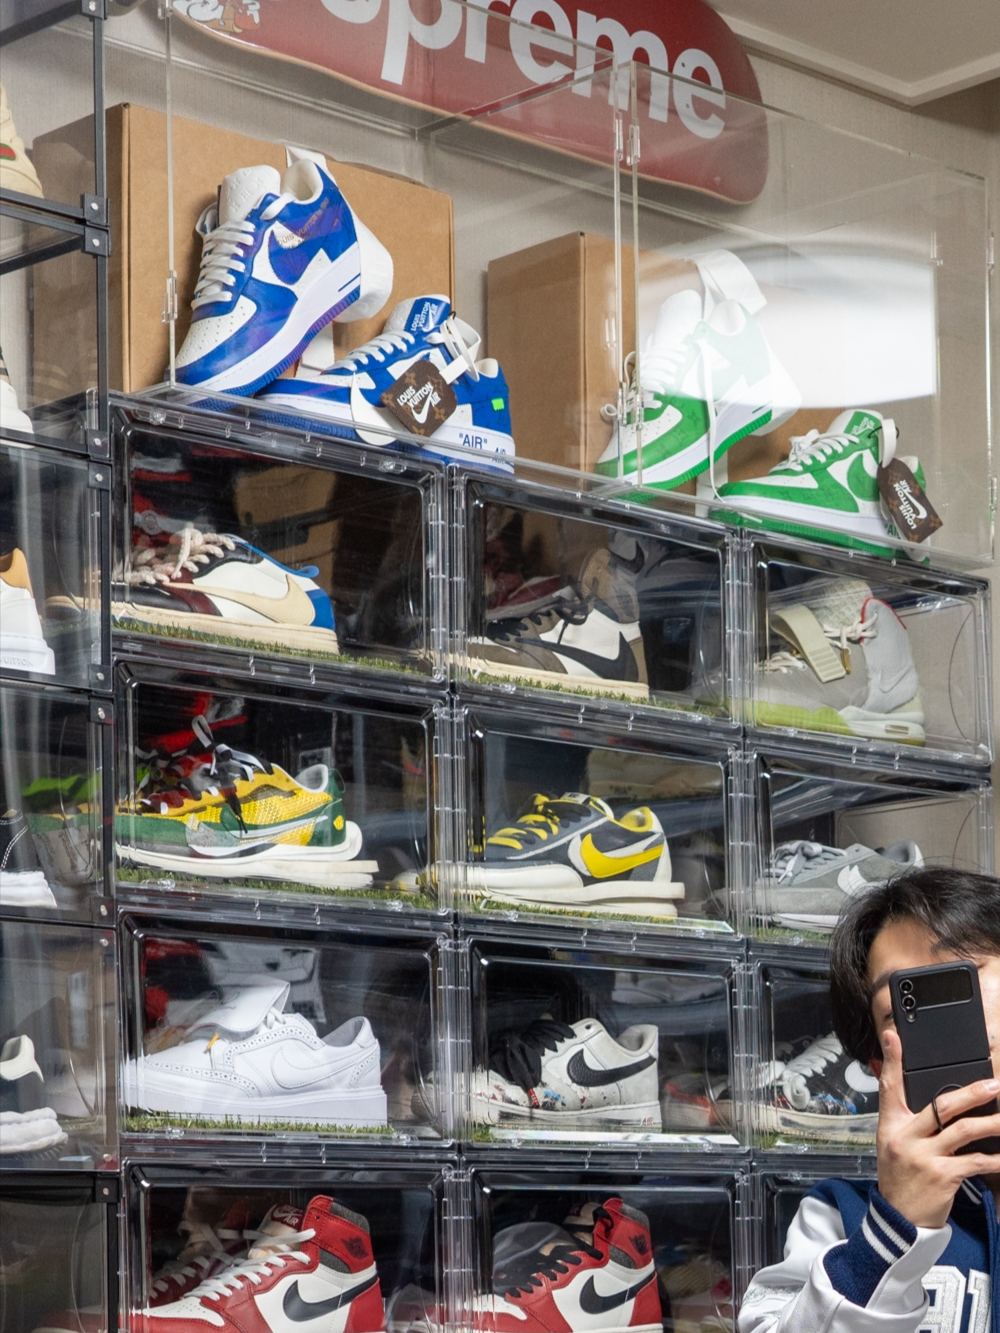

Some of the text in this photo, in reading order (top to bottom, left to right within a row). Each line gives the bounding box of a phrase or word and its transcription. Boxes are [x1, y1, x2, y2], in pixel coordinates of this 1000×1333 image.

[321, 0, 726, 139] preme
[396, 385, 416, 407] LOUIS
[407, 382, 434, 408] VUITTON
[430, 392, 442, 408] AIR
[459, 432, 488, 450] "AIR"
[899, 479, 912, 493] AIR
[893, 482, 917, 520] VUITTON
[899, 505, 918, 530] LOUIS
